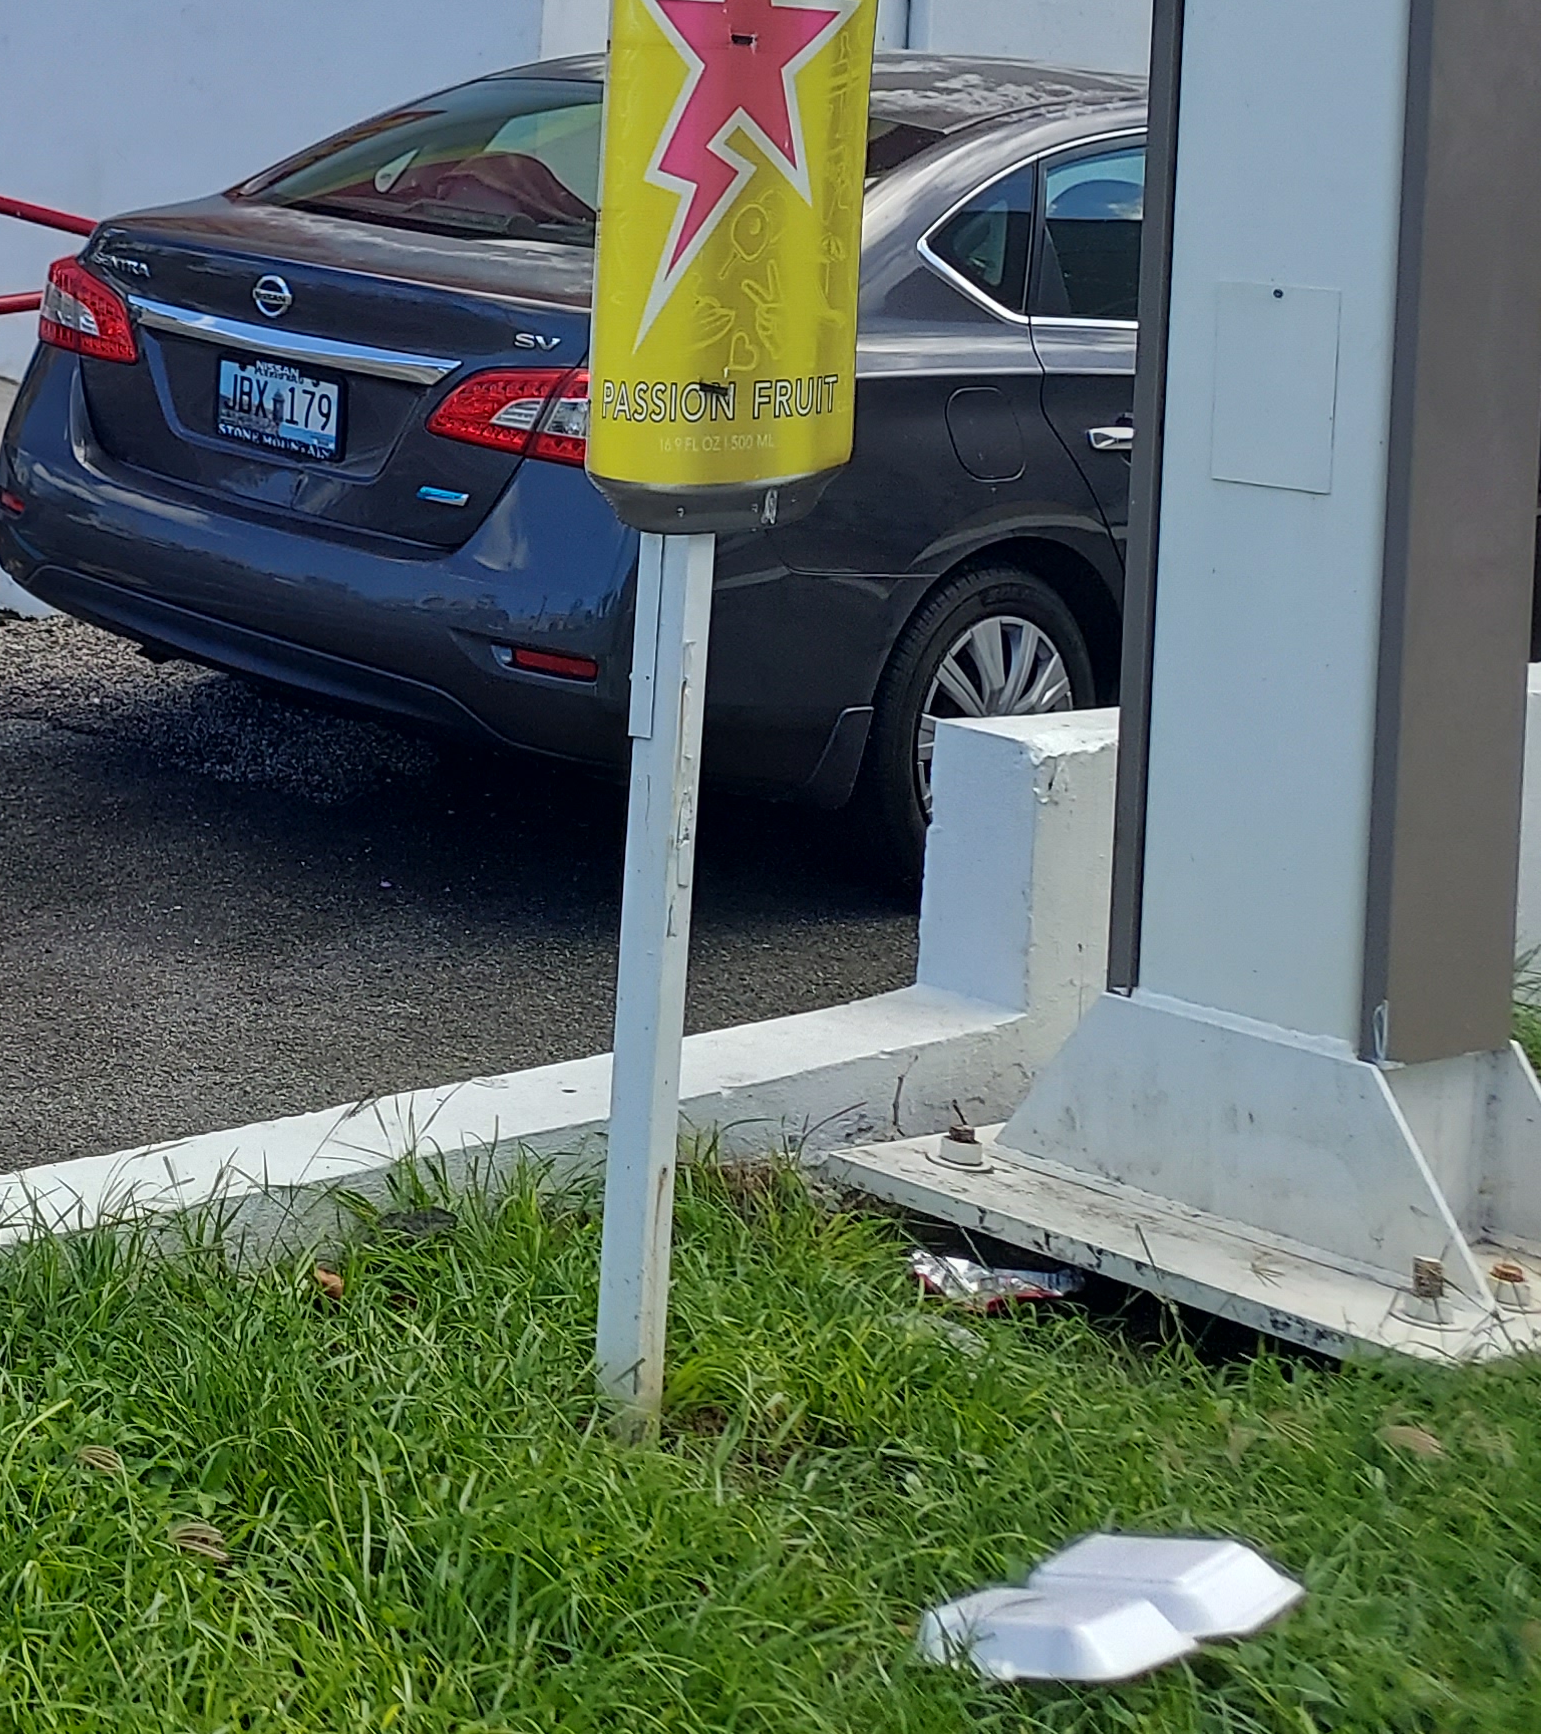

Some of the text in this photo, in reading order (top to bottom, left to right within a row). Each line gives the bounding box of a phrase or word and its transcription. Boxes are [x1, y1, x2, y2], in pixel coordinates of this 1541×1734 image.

[93, 251, 151, 278] SENTRA
[514, 332, 561, 351] SV
[256, 360, 300, 378] NISSAN
[224, 373, 332, 431] JBX 179
[601, 374, 839, 423] PASSION FRUIT
[218, 423, 259, 444] STONE
[702, 436, 721, 452] OZ
[731, 435, 753, 451] 500
